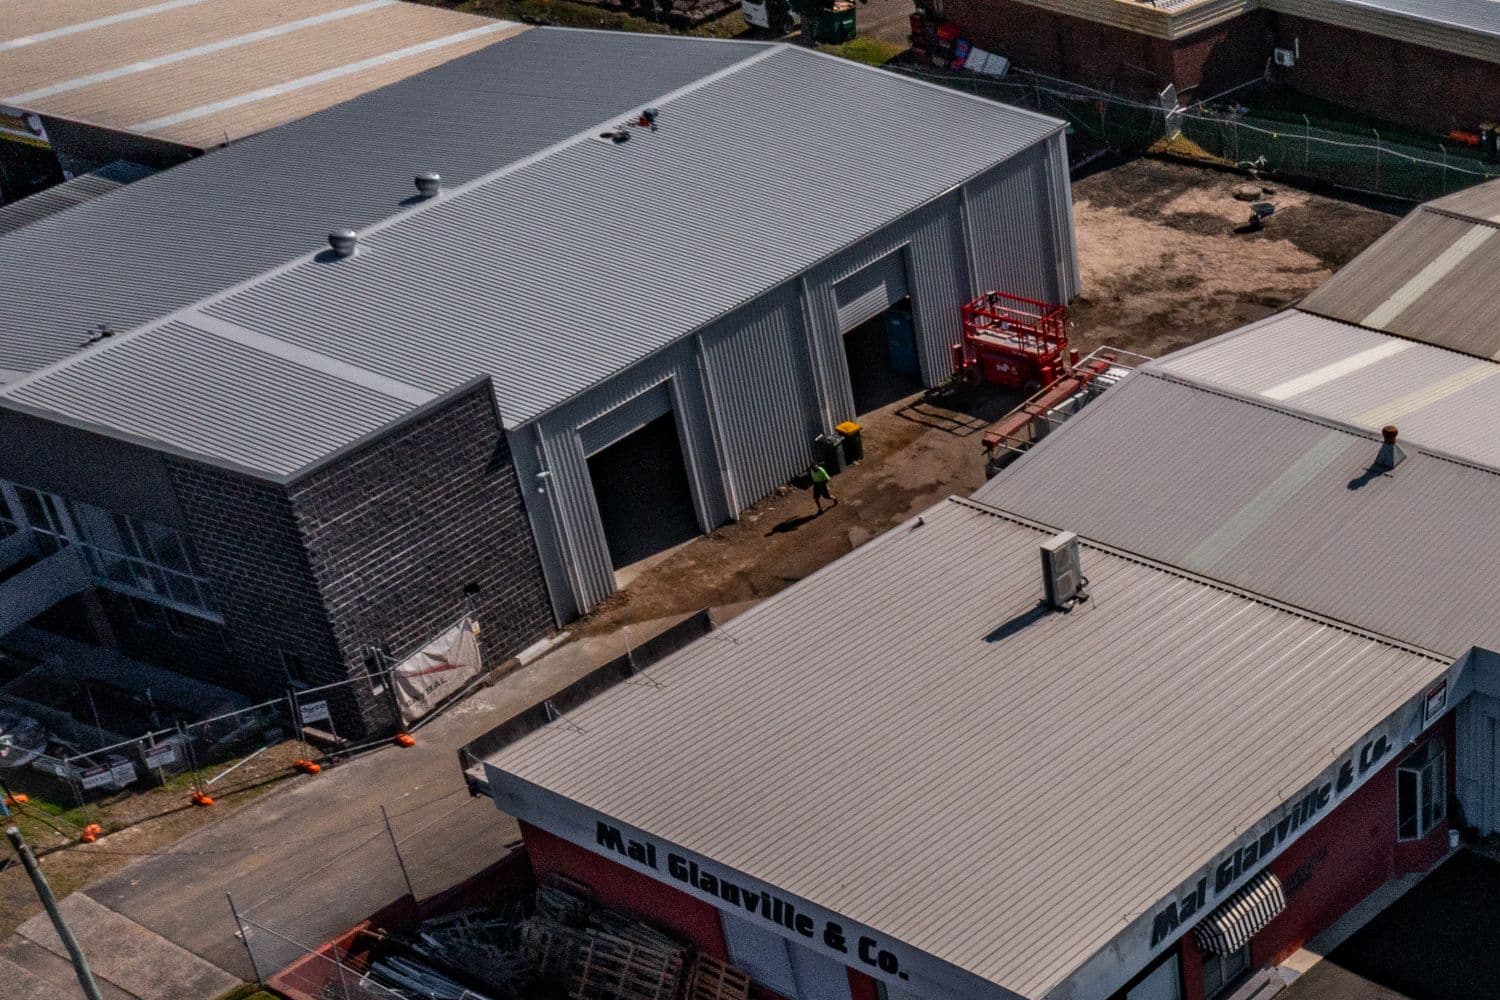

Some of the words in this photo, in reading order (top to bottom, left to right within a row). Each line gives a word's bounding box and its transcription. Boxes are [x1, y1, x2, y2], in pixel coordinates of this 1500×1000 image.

[596, 820, 657, 869] Mal
[667, 852, 815, 939] Glanville
[823, 920, 848, 954] &
[858, 935, 909, 981] Co.
[1151, 876, 1207, 948] Mal
[1214, 782, 1332, 894] Glanville
[1337, 758, 1354, 793] &
[1358, 734, 1392, 775] Co.
